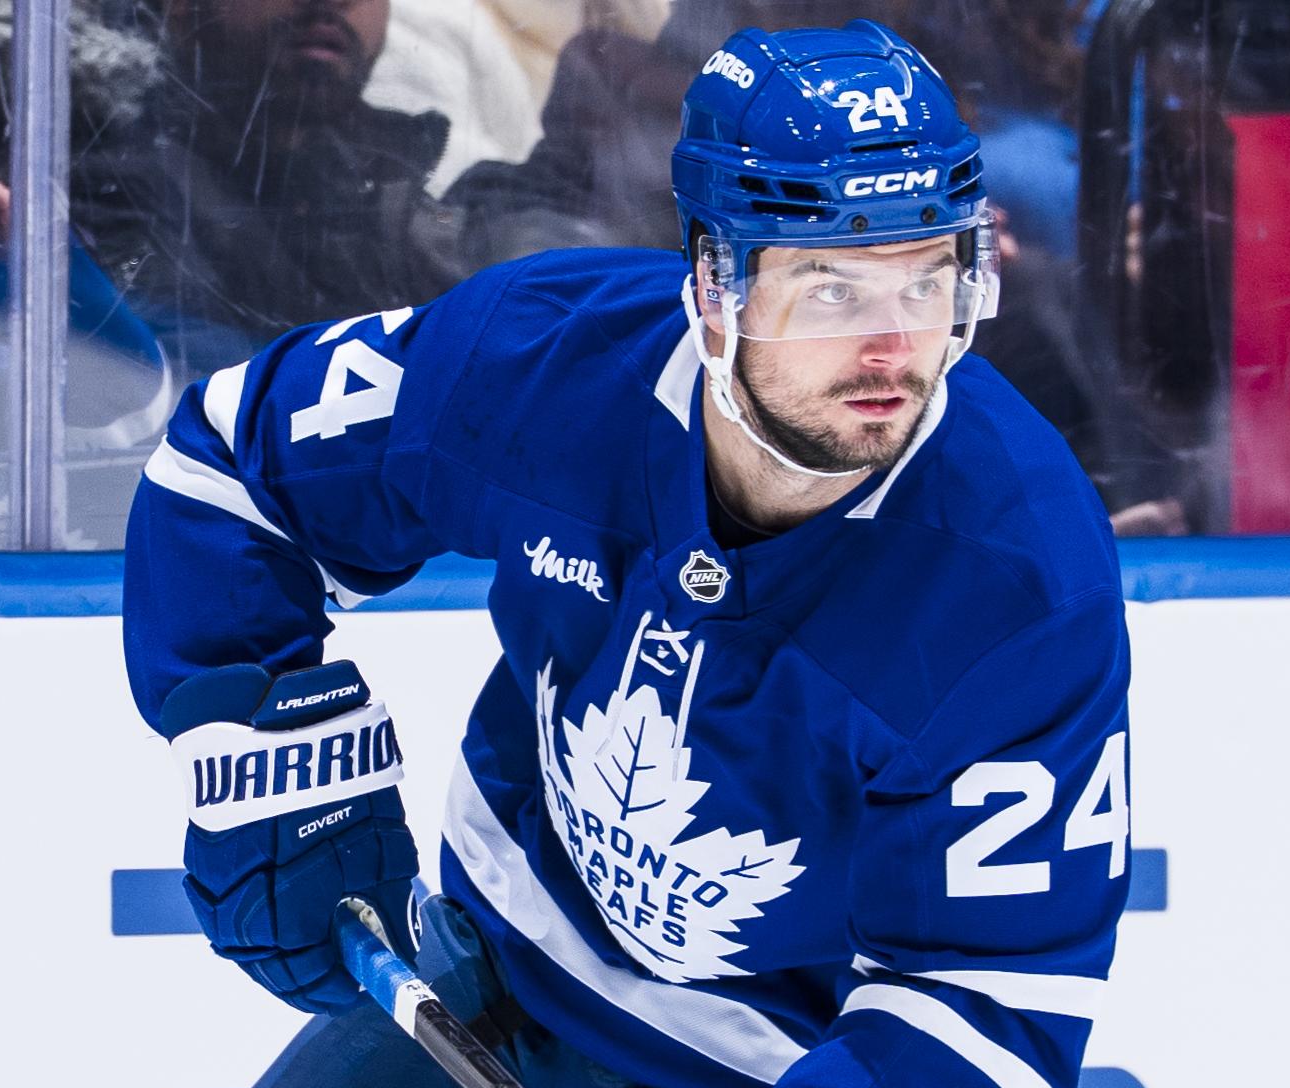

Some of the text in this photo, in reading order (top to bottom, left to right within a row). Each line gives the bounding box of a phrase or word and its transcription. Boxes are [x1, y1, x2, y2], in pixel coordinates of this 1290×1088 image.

[702, 50, 755, 89] OREO
[838, 86, 909, 133] 24
[844, 168, 938, 198] CCM
[524, 536, 610, 602] Milk
[688, 571, 721, 585] NHL
[276, 684, 359, 710] LAUGHTON
[298, 806, 352, 838] COVERT
[946, 731, 1129, 897] 24
[546, 769, 728, 908] TORONTO
[566, 819, 689, 922] MAPLE
[569, 842, 686, 947] LEAFS
